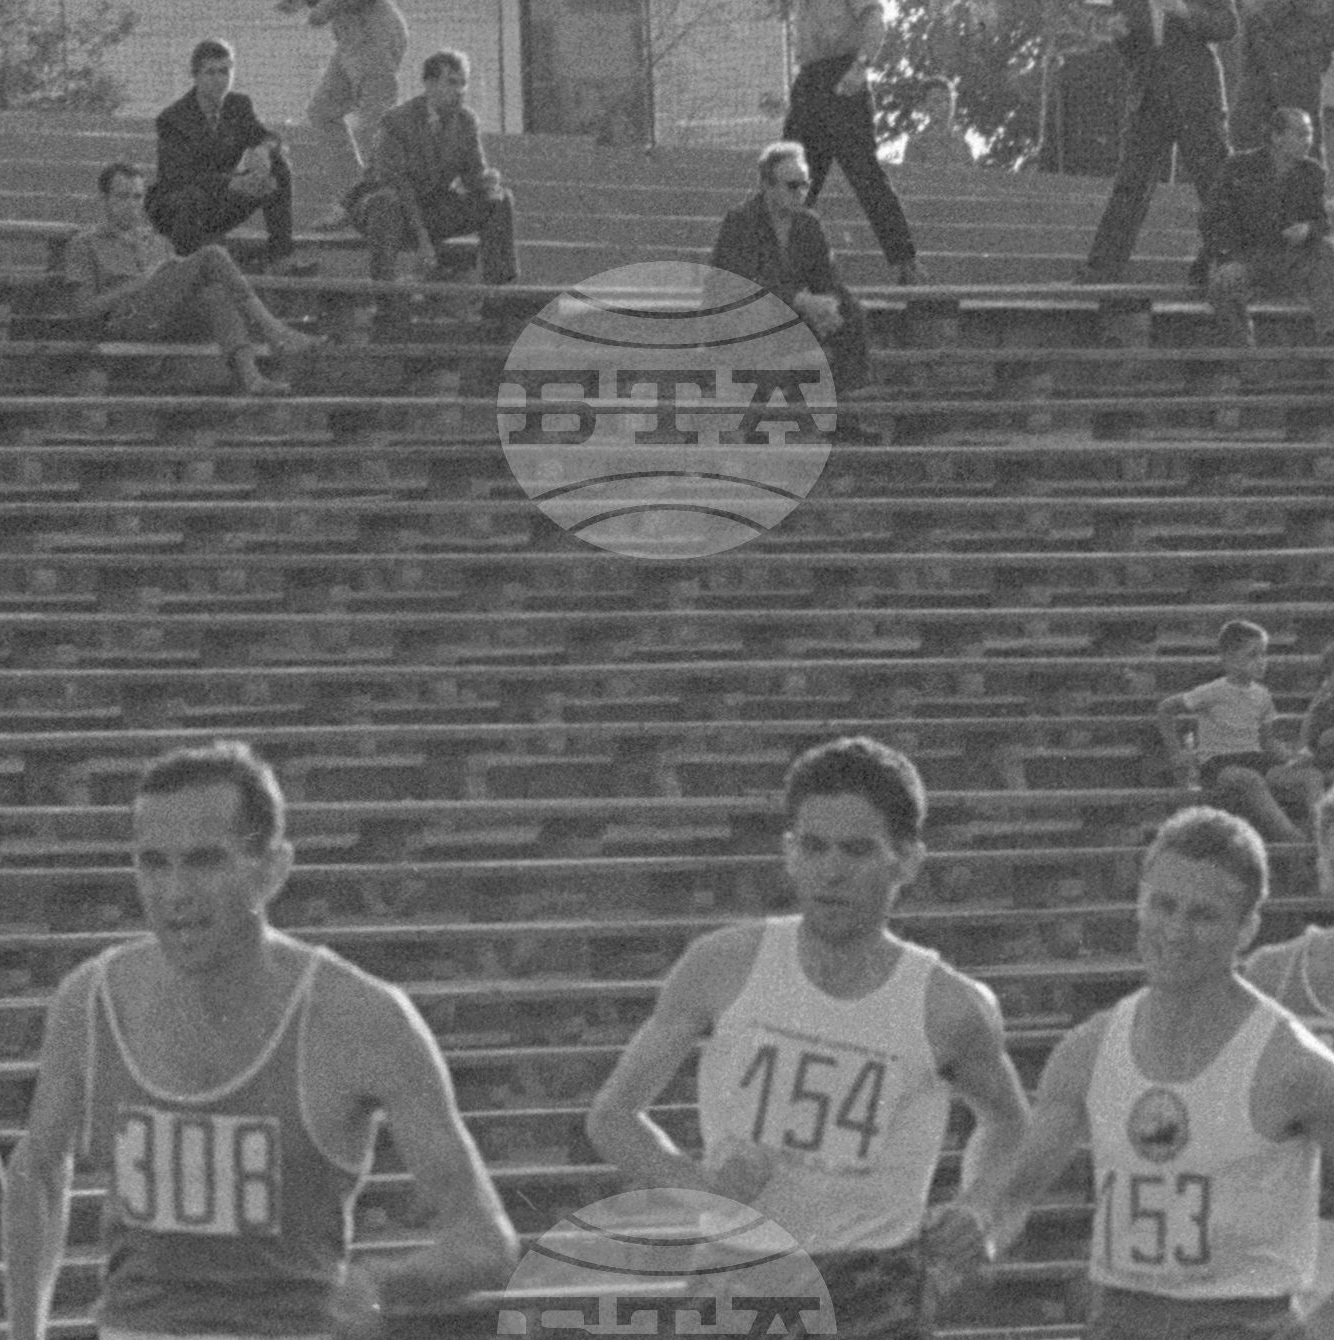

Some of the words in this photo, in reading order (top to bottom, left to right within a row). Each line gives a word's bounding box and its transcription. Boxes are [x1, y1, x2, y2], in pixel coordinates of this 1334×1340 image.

[739, 1044, 886, 1159] 154
[119, 1111, 276, 1231] 308
[1101, 1170, 1212, 1270] 153
